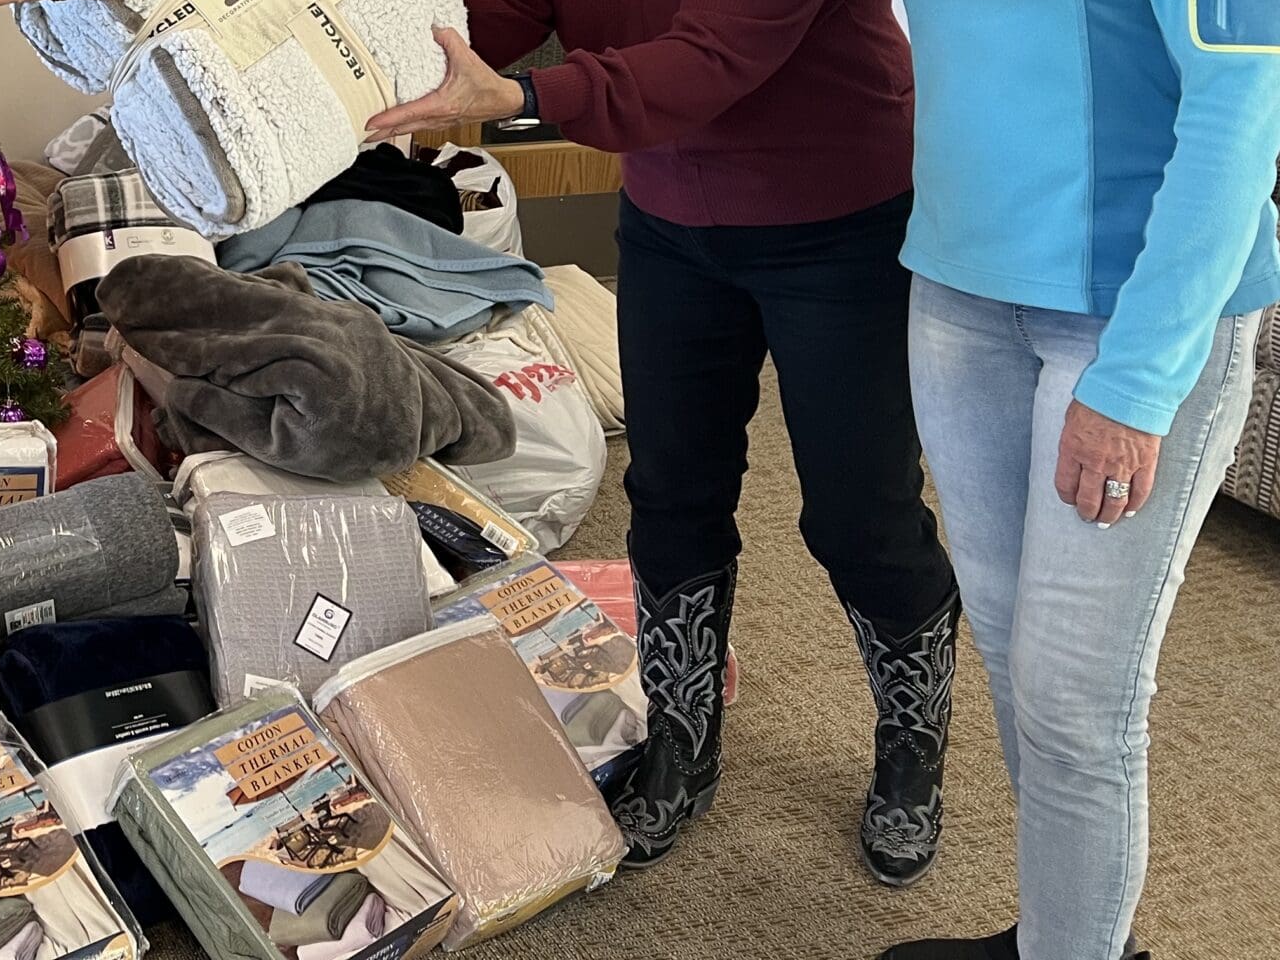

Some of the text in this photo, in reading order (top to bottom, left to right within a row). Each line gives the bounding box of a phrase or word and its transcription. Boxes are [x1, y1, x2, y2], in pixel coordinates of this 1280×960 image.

[105, 235, 114, 246] K
[417, 505, 467, 537] BLANKET
[497, 575, 536, 600] COTTON
[501, 582, 560, 616] THERMAL
[512, 592, 572, 629] BLANKET
[237, 724, 283, 753] COTTON
[238, 734, 309, 776] THERMAL
[250, 749, 322, 793] BLANKET
